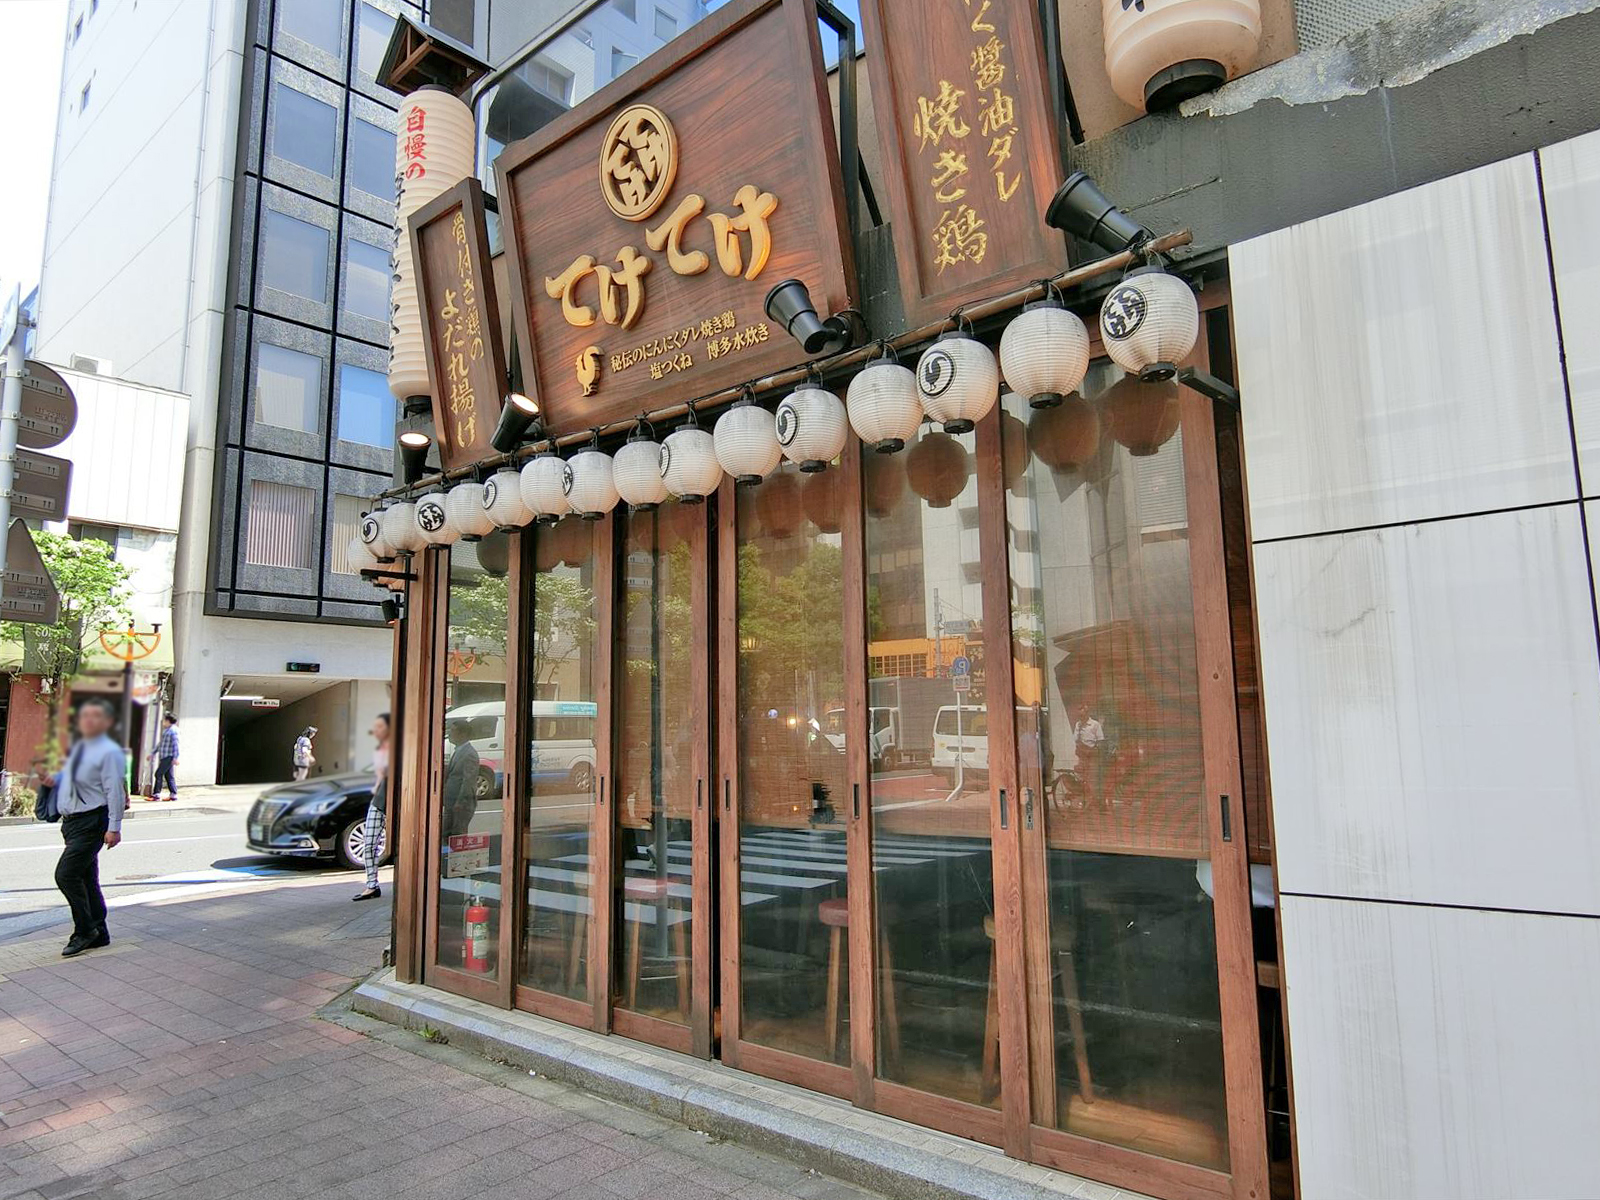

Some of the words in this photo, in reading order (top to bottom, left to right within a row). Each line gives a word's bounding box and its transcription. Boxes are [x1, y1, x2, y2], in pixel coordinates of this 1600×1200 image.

[405, 106, 427, 180] 自慢の
[913, 80, 988, 276] 焼き鶏
[545, 184, 778, 330] てけてけ
[441, 288, 476, 448] よだれ揚げ
[650, 352, 693, 380] 塩つくね
[706, 322, 769, 360] 博多水炊き
